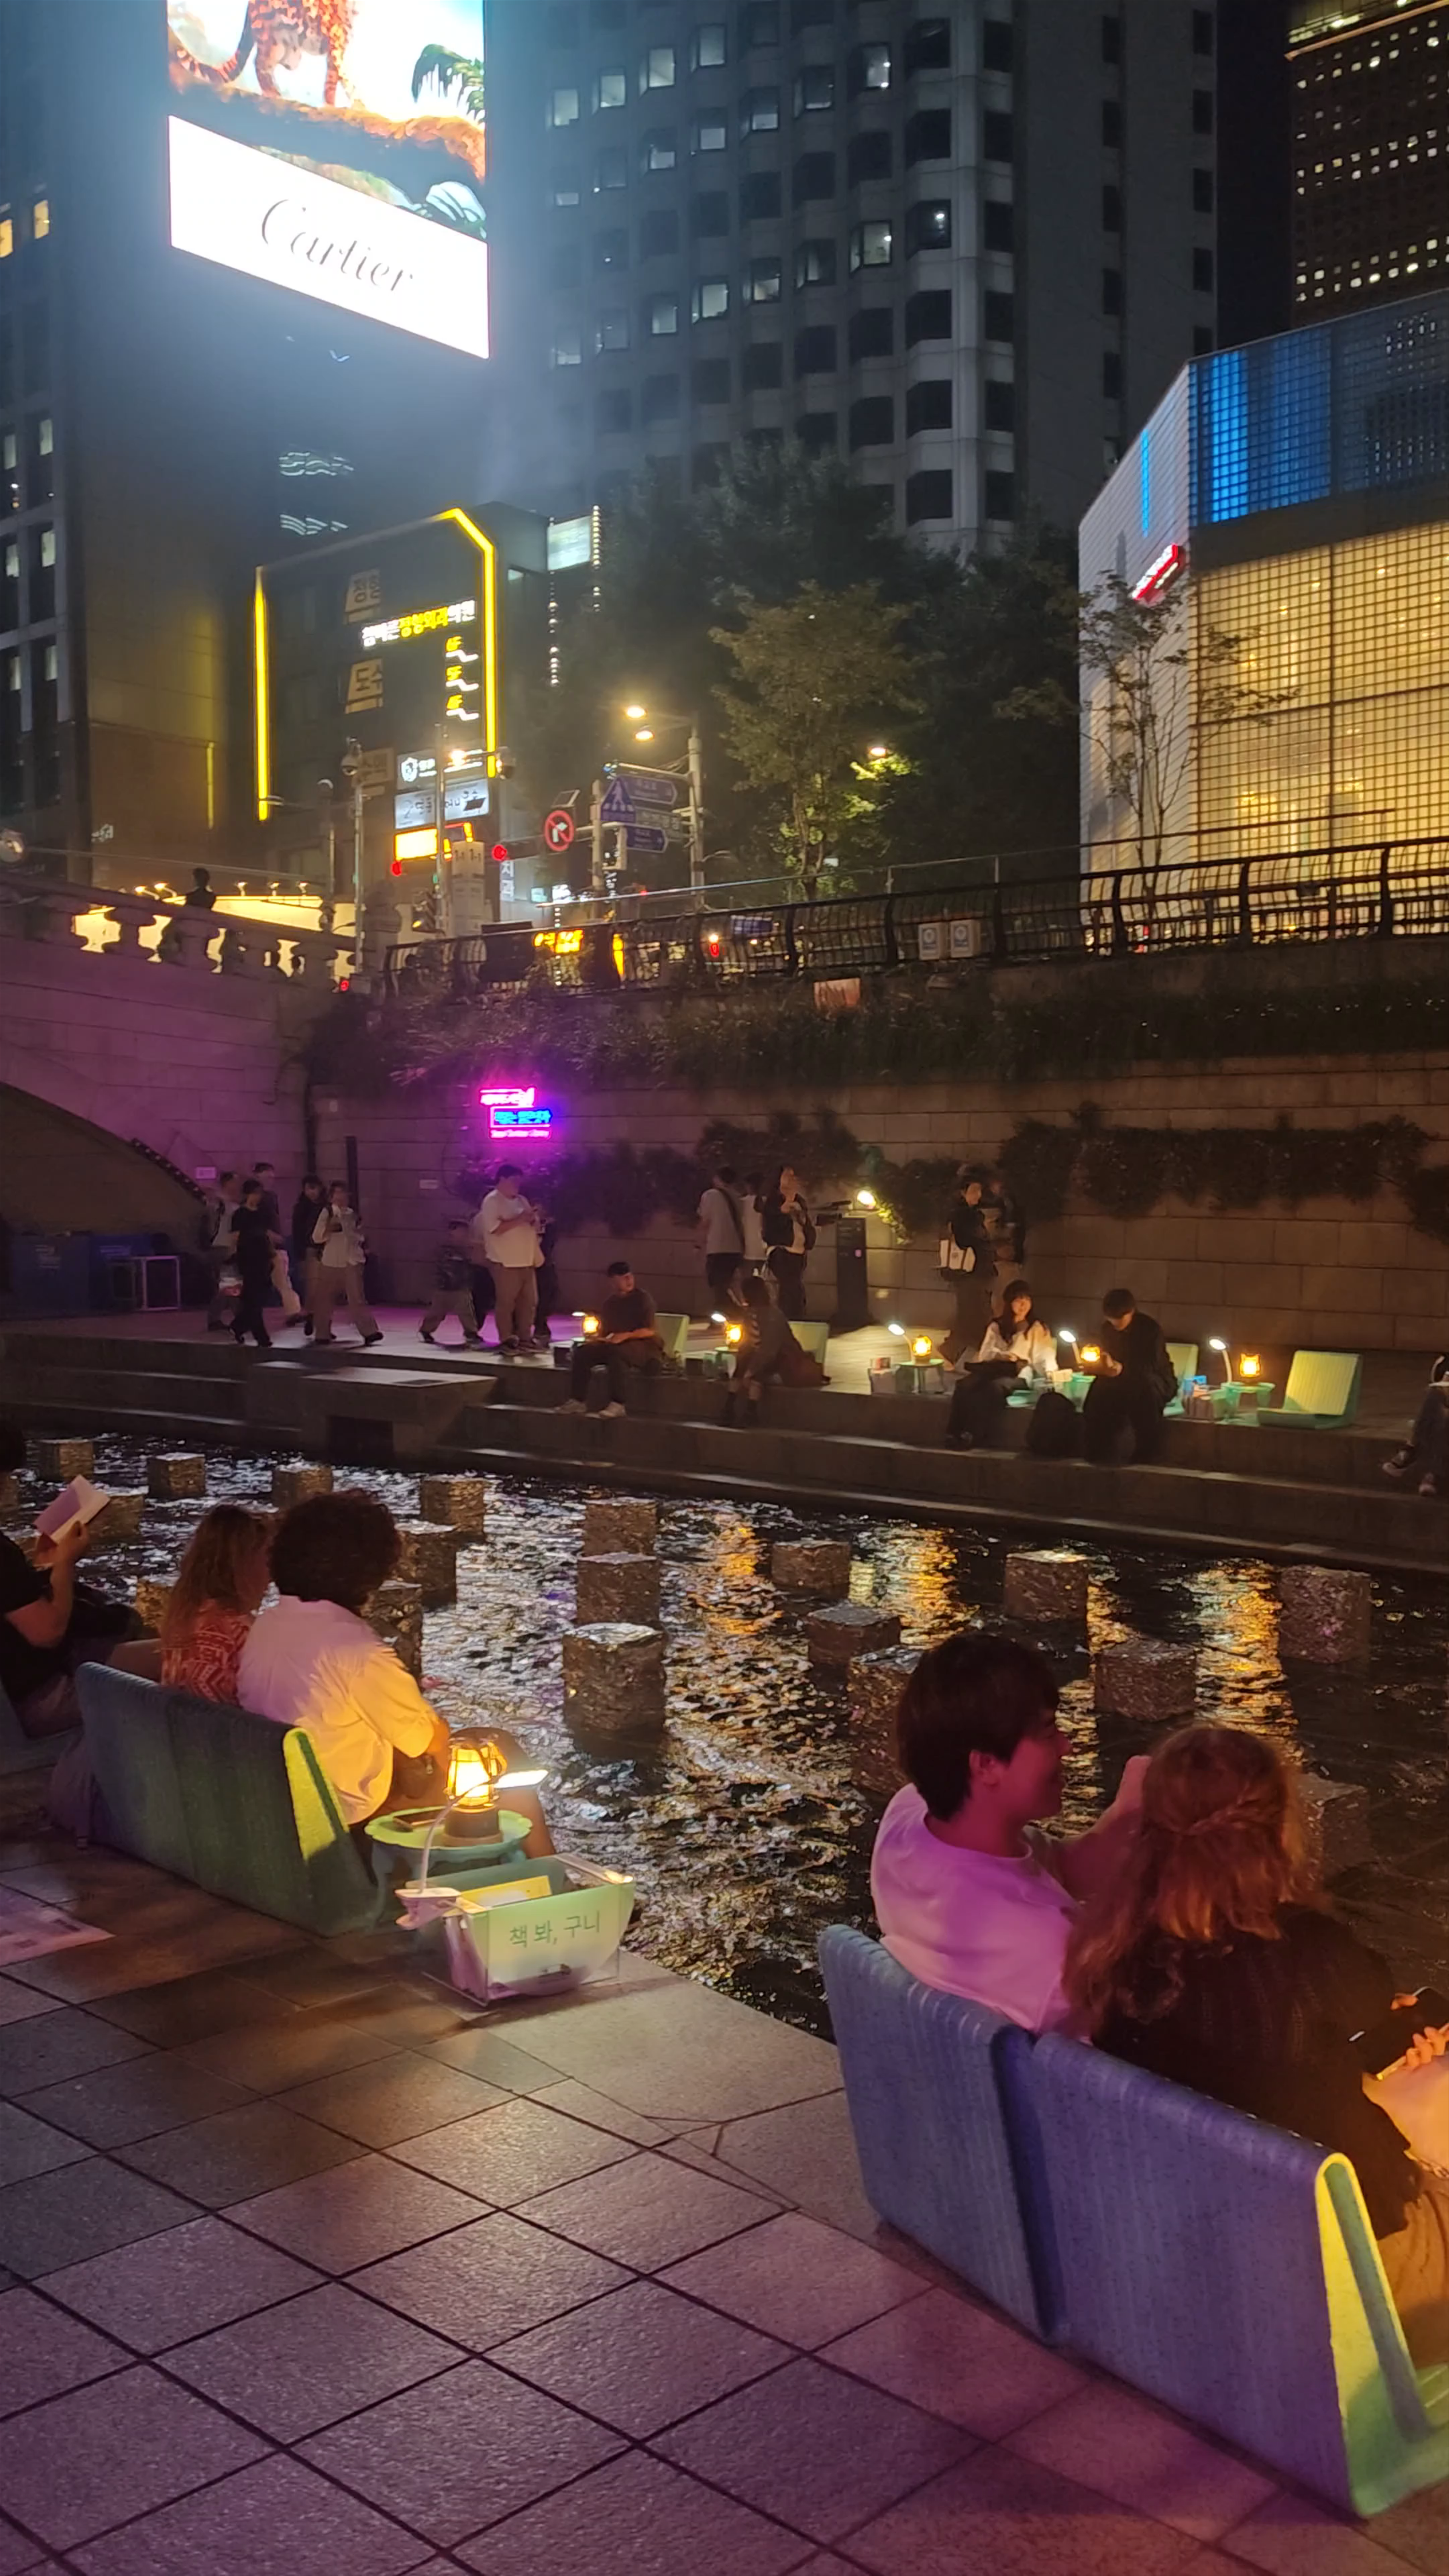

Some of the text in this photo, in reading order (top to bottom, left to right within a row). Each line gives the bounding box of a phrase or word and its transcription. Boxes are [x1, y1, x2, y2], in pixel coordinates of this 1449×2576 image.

[261, 199, 413, 291] Cartier
[509, 1924, 528, 1947] 책
[563, 1910, 600, 1938] 구니
